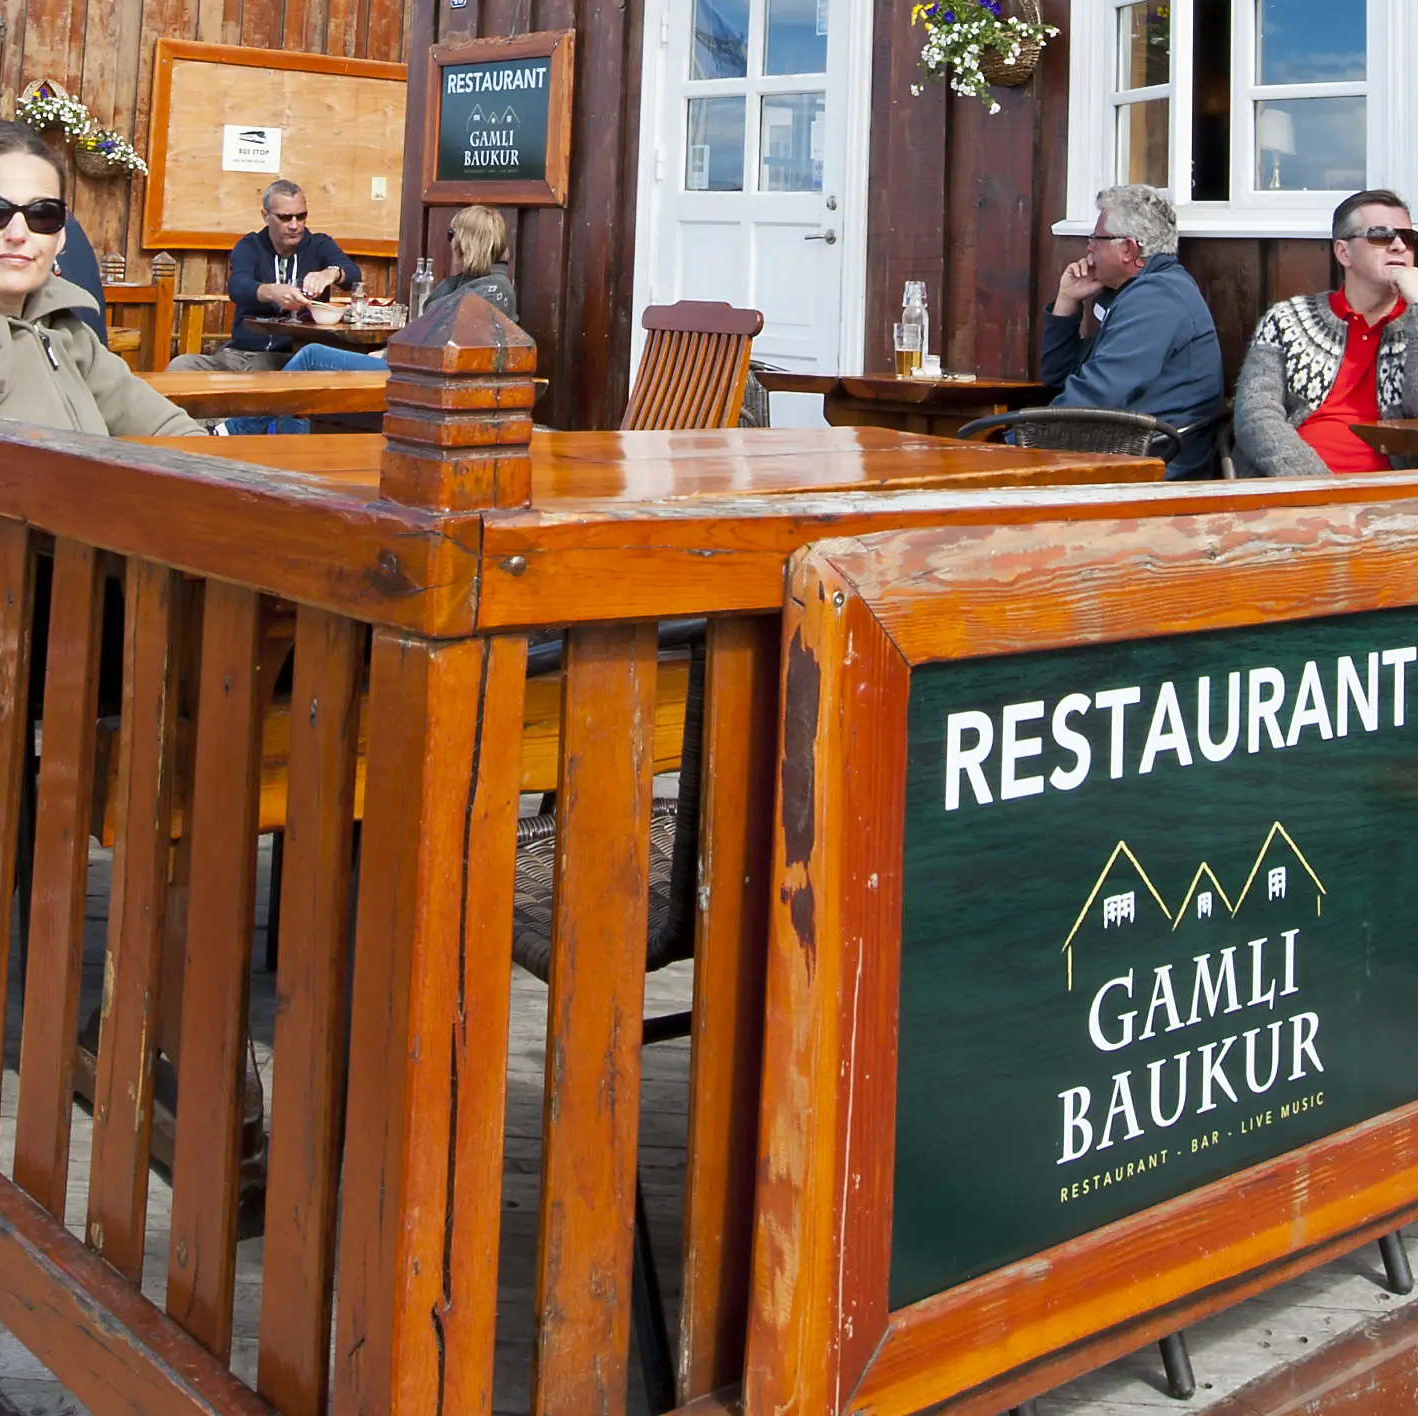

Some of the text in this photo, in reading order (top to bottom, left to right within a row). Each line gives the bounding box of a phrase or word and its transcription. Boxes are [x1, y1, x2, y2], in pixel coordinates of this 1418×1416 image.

[447, 67, 547, 94] RESTAURANT
[252, 148, 270, 156] STOP
[463, 149, 520, 166] BAUKUR
[469, 130, 514, 147] GAMLI
[944, 646, 1418, 811] RESTAURANT
[1087, 928, 1300, 1051] GAMLI
[1056, 1011, 1325, 1165] BAUKUR
[1059, 1149, 1169, 1203] RESTAURANT
[1191, 1131, 1219, 1153] BAR
[1240, 1110, 1273, 1134] LIVE
[1280, 1091, 1325, 1119] MUSIC
